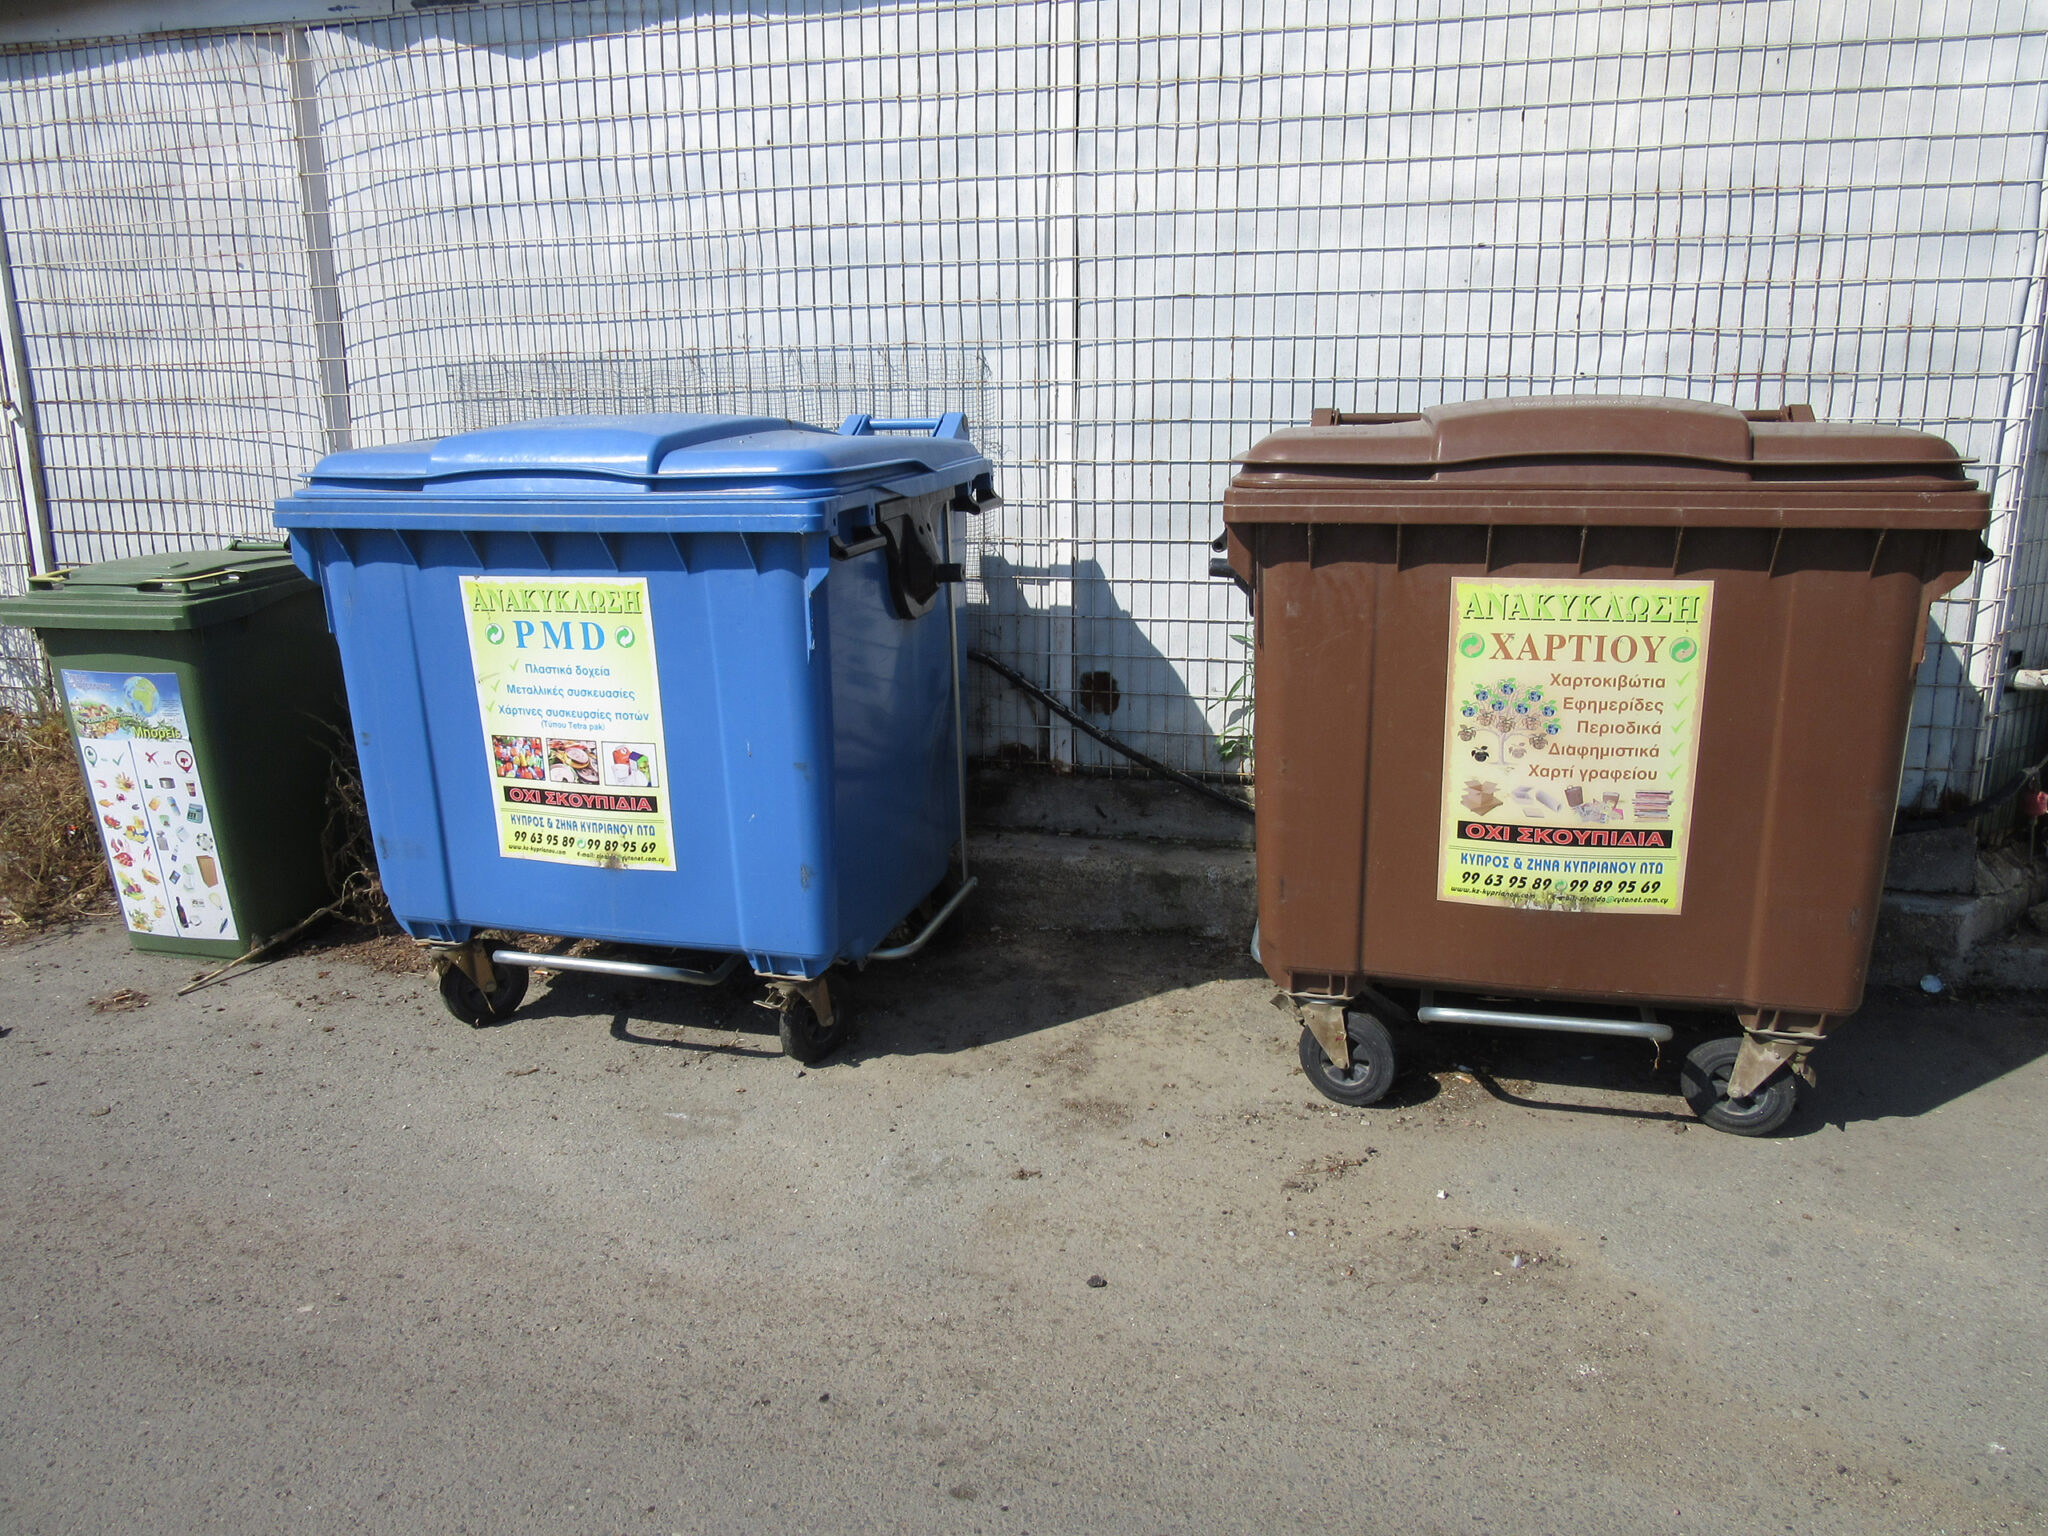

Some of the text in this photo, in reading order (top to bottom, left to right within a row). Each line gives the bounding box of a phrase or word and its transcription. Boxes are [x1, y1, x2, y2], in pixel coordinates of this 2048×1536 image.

[473, 588, 643, 614] ΑΝΑΚΥΚΛΩΣΗ
[1463, 592, 1701, 623] ΑΝΑΚΥΚΛΩΣΗ
[512, 620, 606, 650] PMD
[1489, 632, 1667, 663] ΧΑΡΤΙΟΥ
[524, 663, 611, 678] Πλαστικά δοχεία
[1550, 672, 1666, 691] Χαρτοκιβώτια
[506, 684, 636, 701] Μεταλλικές συσκευασίες
[498, 704, 543, 718] Χάρτινες
[615, 710, 650, 721] ποτών
[1562, 697, 1664, 715] Εφημερίδες
[1577, 720, 1662, 737] Περιοδικά
[1548, 743, 1660, 760] Διαφημιστικά
[1528, 764, 1658, 783] Χαρτί γραφείου
[509, 788, 652, 812] ΟΧΙ ΣΚΟΥΠΙΔΙΑ
[510, 814, 545, 828] ΚΥΠΡΟΣ
[556, 819, 579, 832] ΖΗΝΑ
[580, 821, 634, 836] ΚΥΠΡΙΑΝΟΥ
[1465, 823, 1665, 847] ΟΧΙ ΣΚΟΥΠΙΔΙΑ
[514, 831, 656, 853] 99 63 95 89 99 89 95 69
[1460, 852, 1509, 869] ΚΥΠΡΟΣ
[1513, 858, 1522, 870] &
[1527, 858, 1560, 872] ΖΗΝΑ
[1564, 861, 1636, 874] ΚΥΠΡΙΑΝΟΥ
[1462, 871, 1661, 893] 99 63 95 89 99 89 95 69
